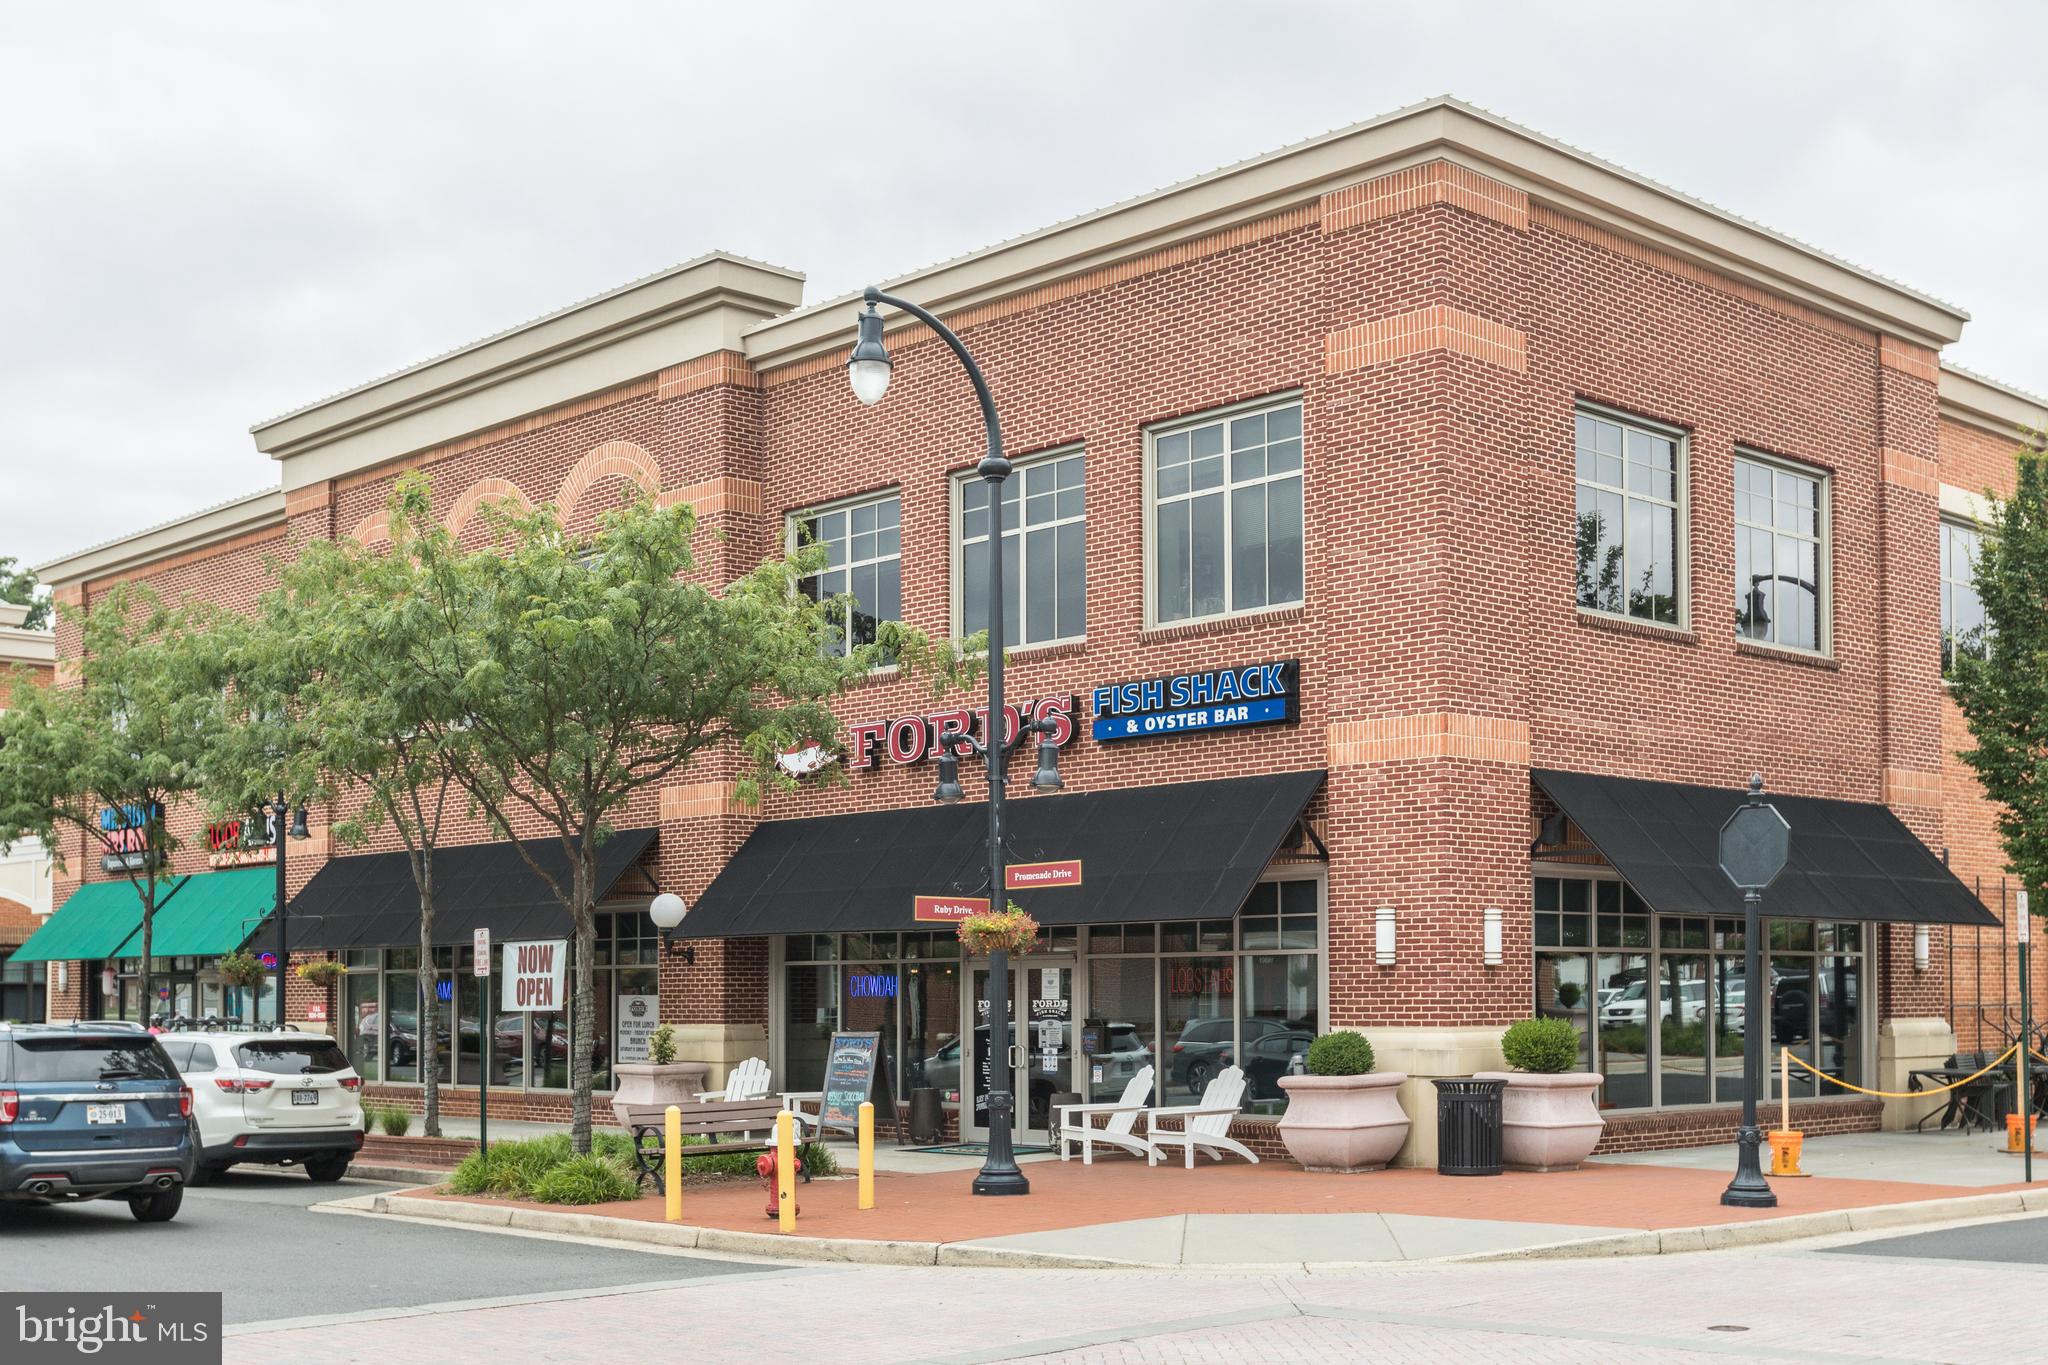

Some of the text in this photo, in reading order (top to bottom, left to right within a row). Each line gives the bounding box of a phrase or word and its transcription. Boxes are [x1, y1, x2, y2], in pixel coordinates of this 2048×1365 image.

[1093, 663, 1285, 716] FISH SHACK
[850, 694, 1072, 768] FORD'S
[1127, 706, 1249, 733] & OYSTER BAR
[1014, 869, 1072, 881] Promenade Drive
[934, 905, 973, 915] Ruby Drive
[518, 944, 554, 974] NOW
[516, 977, 553, 1007] OPEN
[850, 975, 899, 998] CHOWDAH
[1032, 999, 1068, 1008] FORD'S
